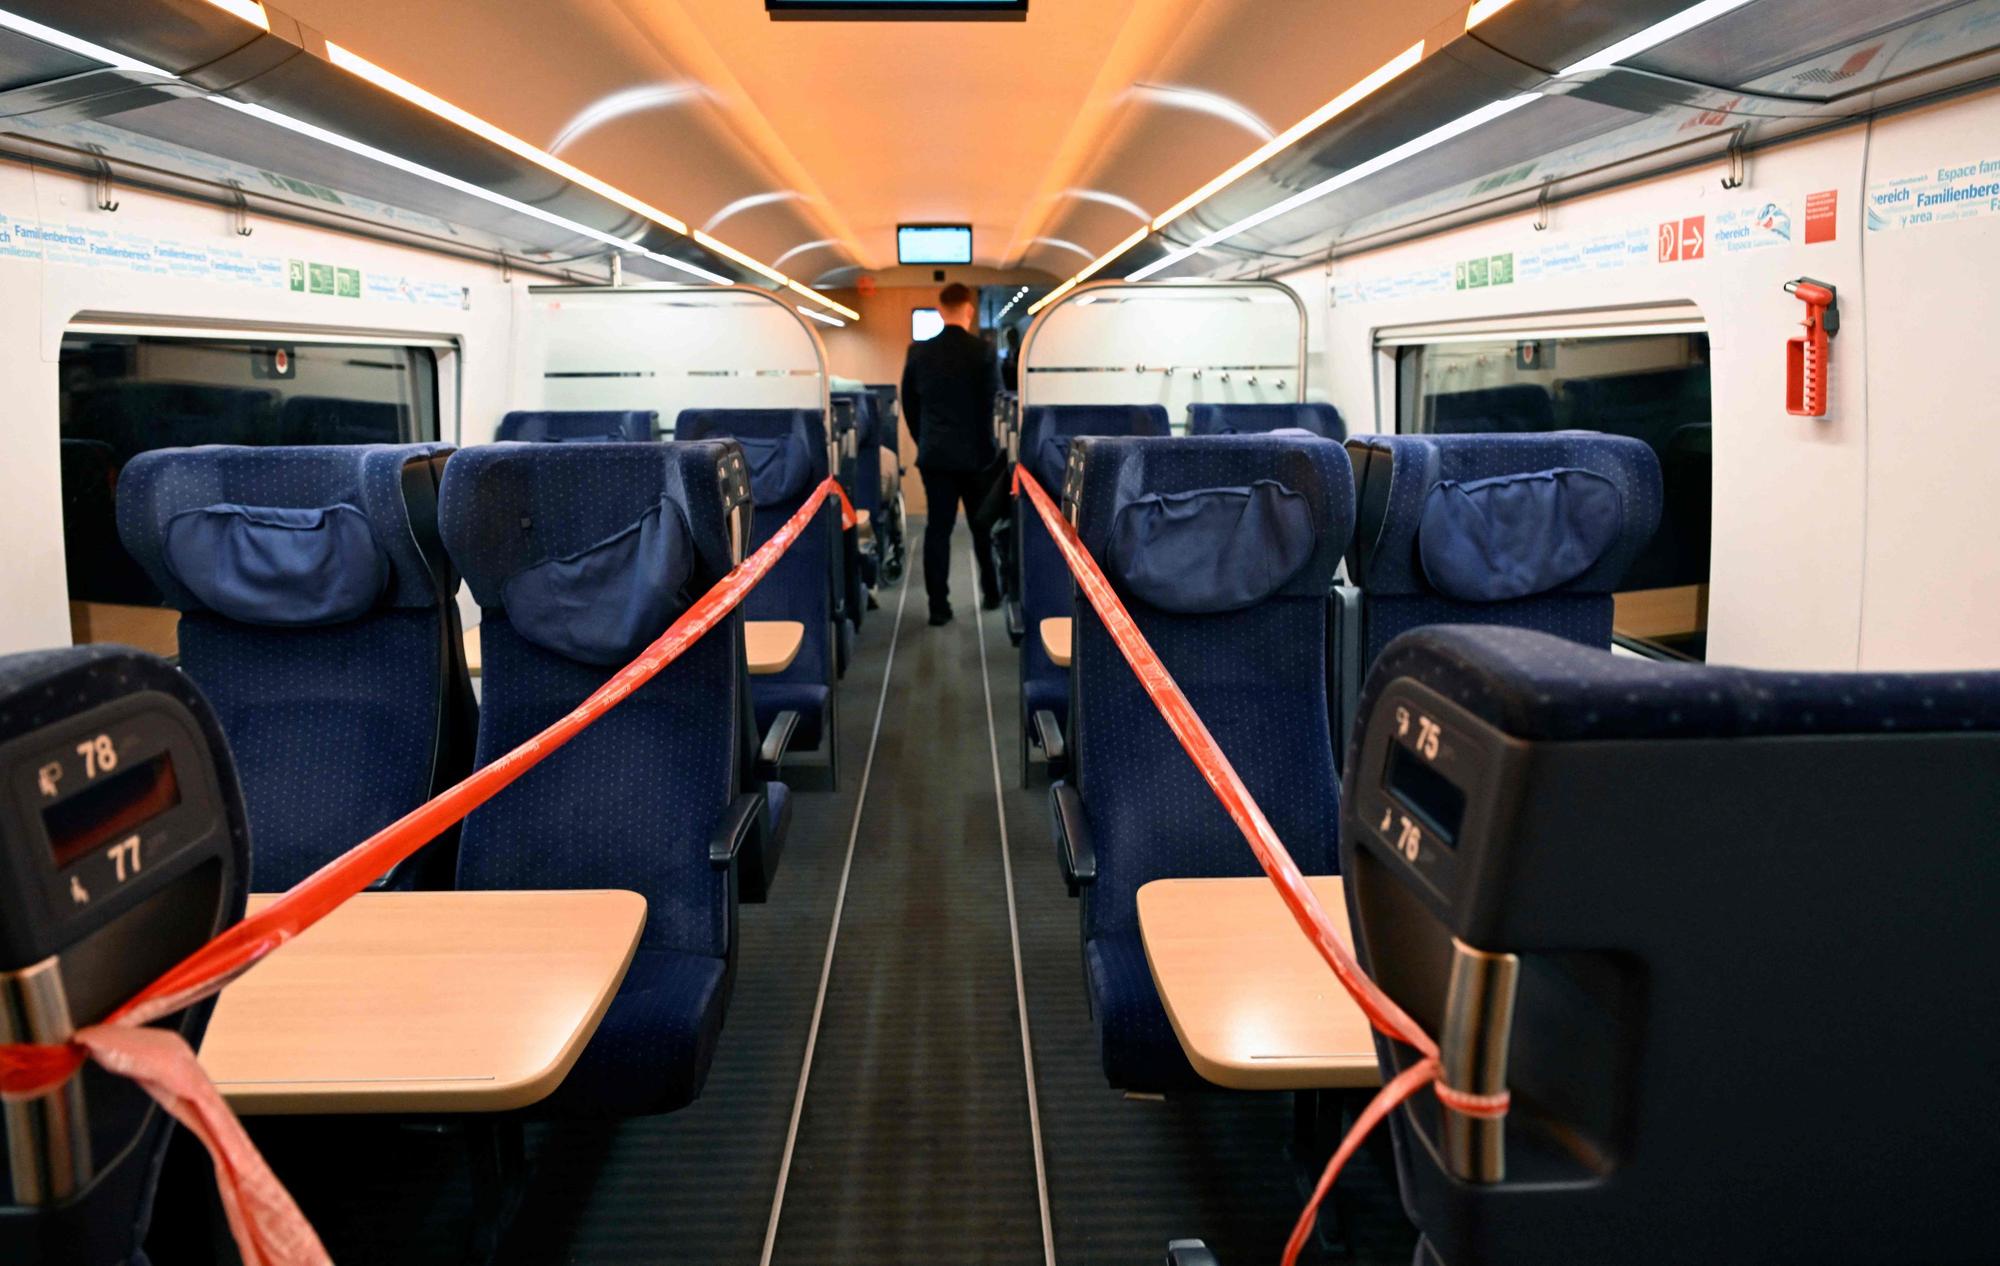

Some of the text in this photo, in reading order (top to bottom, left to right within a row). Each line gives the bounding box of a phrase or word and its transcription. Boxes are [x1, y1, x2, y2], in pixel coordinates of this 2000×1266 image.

[1937, 164, 1977, 183] Espace
[1909, 211, 1933, 225] area
[14, 224, 86, 246] Familienbereich
[89, 243, 151, 261] Familienbereich
[1415, 716, 1442, 761] 75
[76, 734, 118, 779] 78
[1397, 816, 1422, 862] 76
[107, 834, 141, 882] 77
